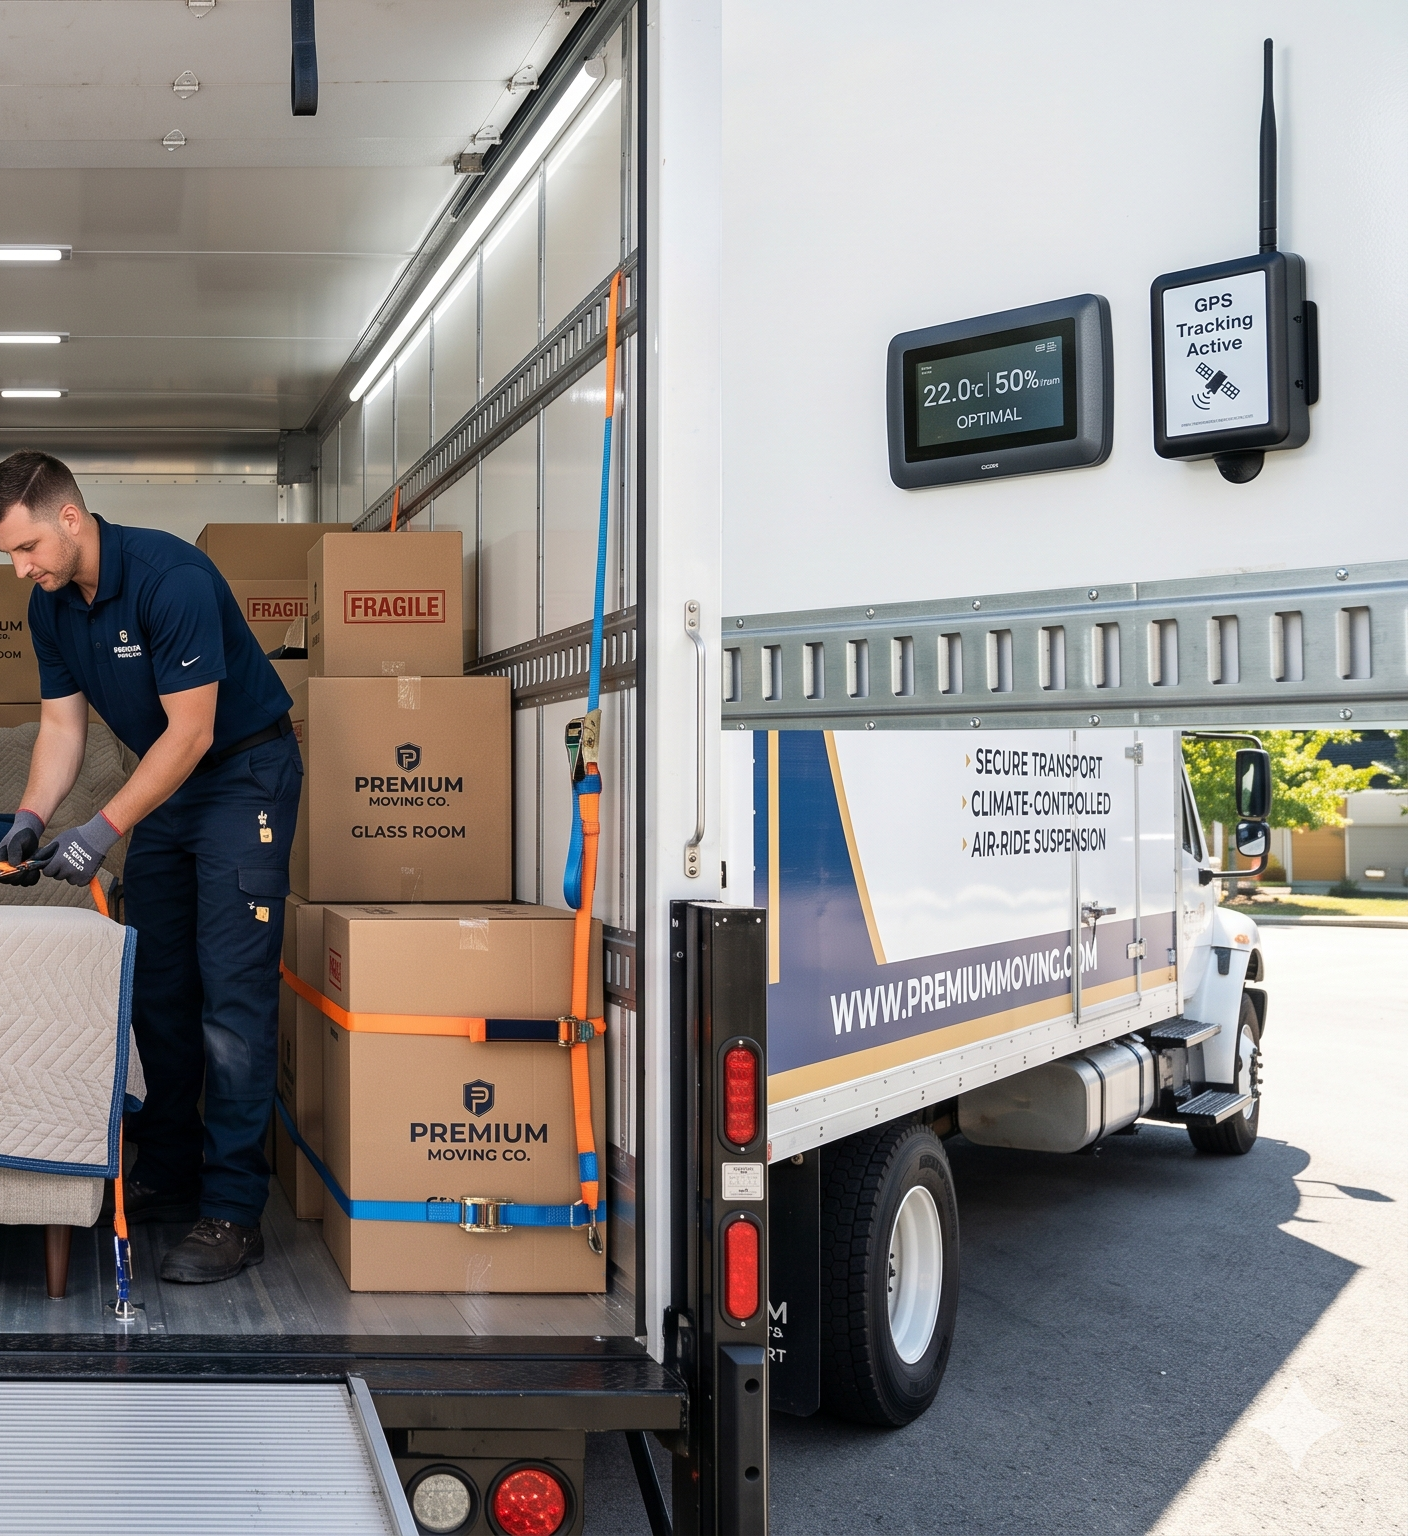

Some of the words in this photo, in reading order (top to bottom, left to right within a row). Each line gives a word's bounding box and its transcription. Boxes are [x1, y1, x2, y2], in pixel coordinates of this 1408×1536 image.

[1194, 293, 1233, 313] GPS
[1176, 314, 1253, 338] Tracking
[1186, 338, 1243, 358] Active
[956, 407, 1023, 429] OPTIMAL
[350, 596, 439, 618] FRAGILE
[975, 747, 1028, 776] SECURE
[1032, 751, 1103, 779] TRANSPORT
[355, 776, 464, 793] PREMIUM
[368, 797, 425, 808] MOVING
[427, 797, 450, 808] CO.
[351, 825, 409, 839] GLASS
[412, 825, 466, 839] ROOM
[1034, 828, 1106, 853] SUSPENSION
[409, 1122, 548, 1143] PREMIUM
[427, 1149, 498, 1161] MOVING
[501, 1149, 531, 1161] CO.
